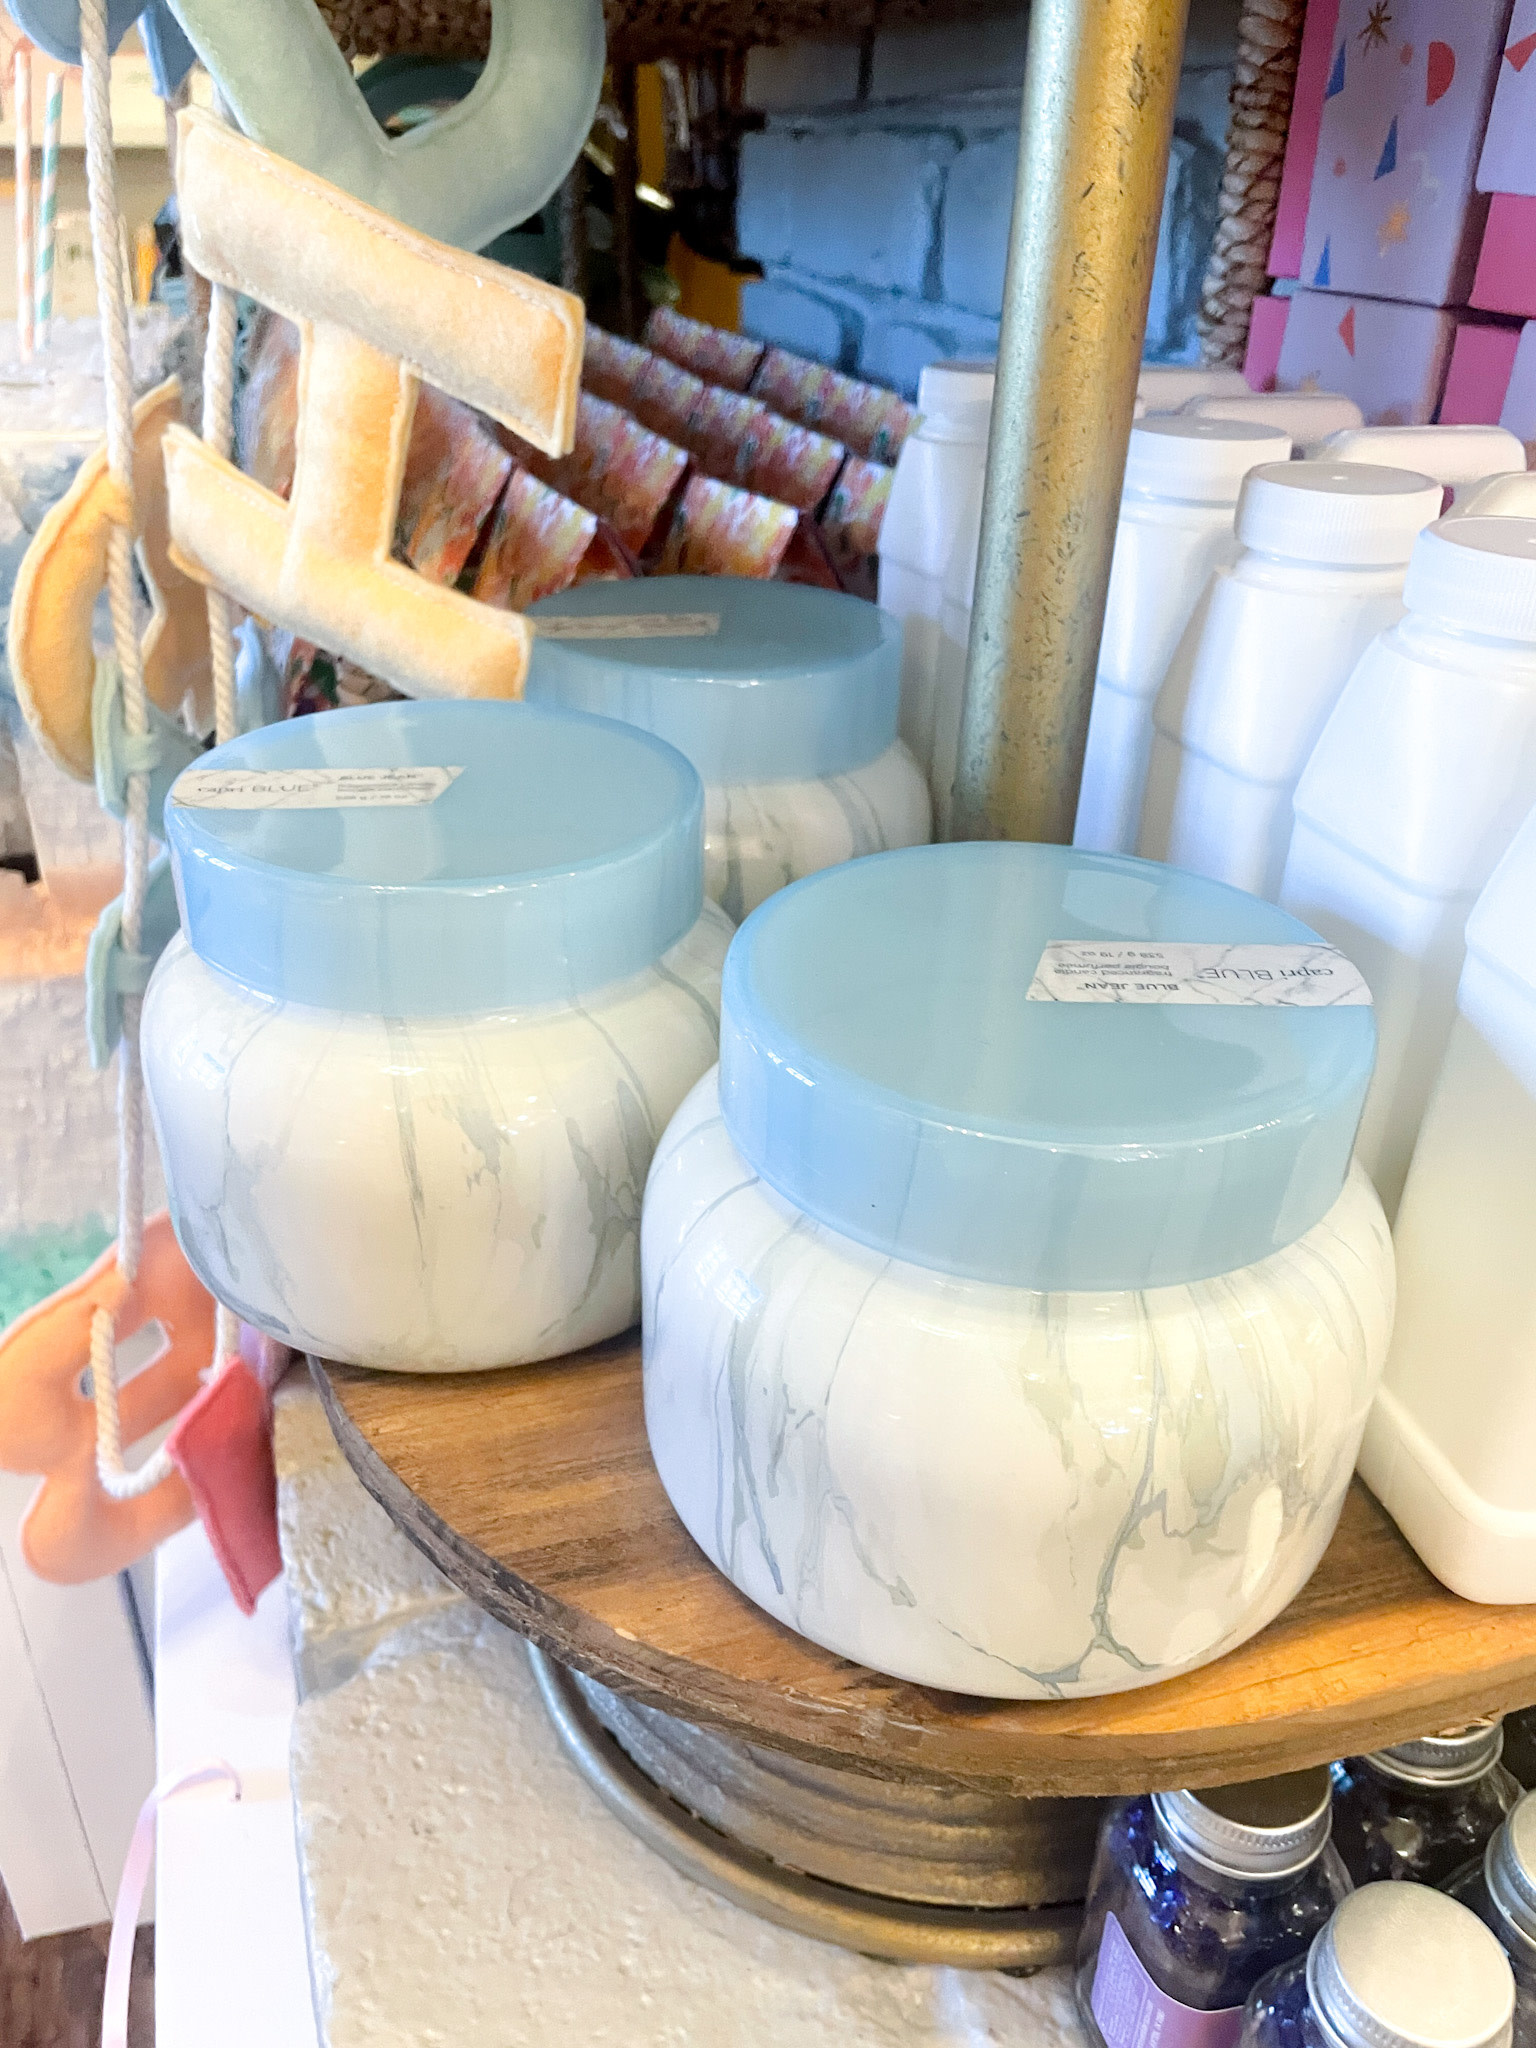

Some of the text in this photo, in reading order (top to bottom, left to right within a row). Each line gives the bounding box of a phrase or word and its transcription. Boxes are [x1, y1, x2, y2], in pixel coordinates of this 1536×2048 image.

[252, 784, 311, 793] BLUE
[1053, 968, 1097, 976] candle
[1200, 966, 1334, 981] capri BLUE
[1134, 983, 1179, 991] BLUE
